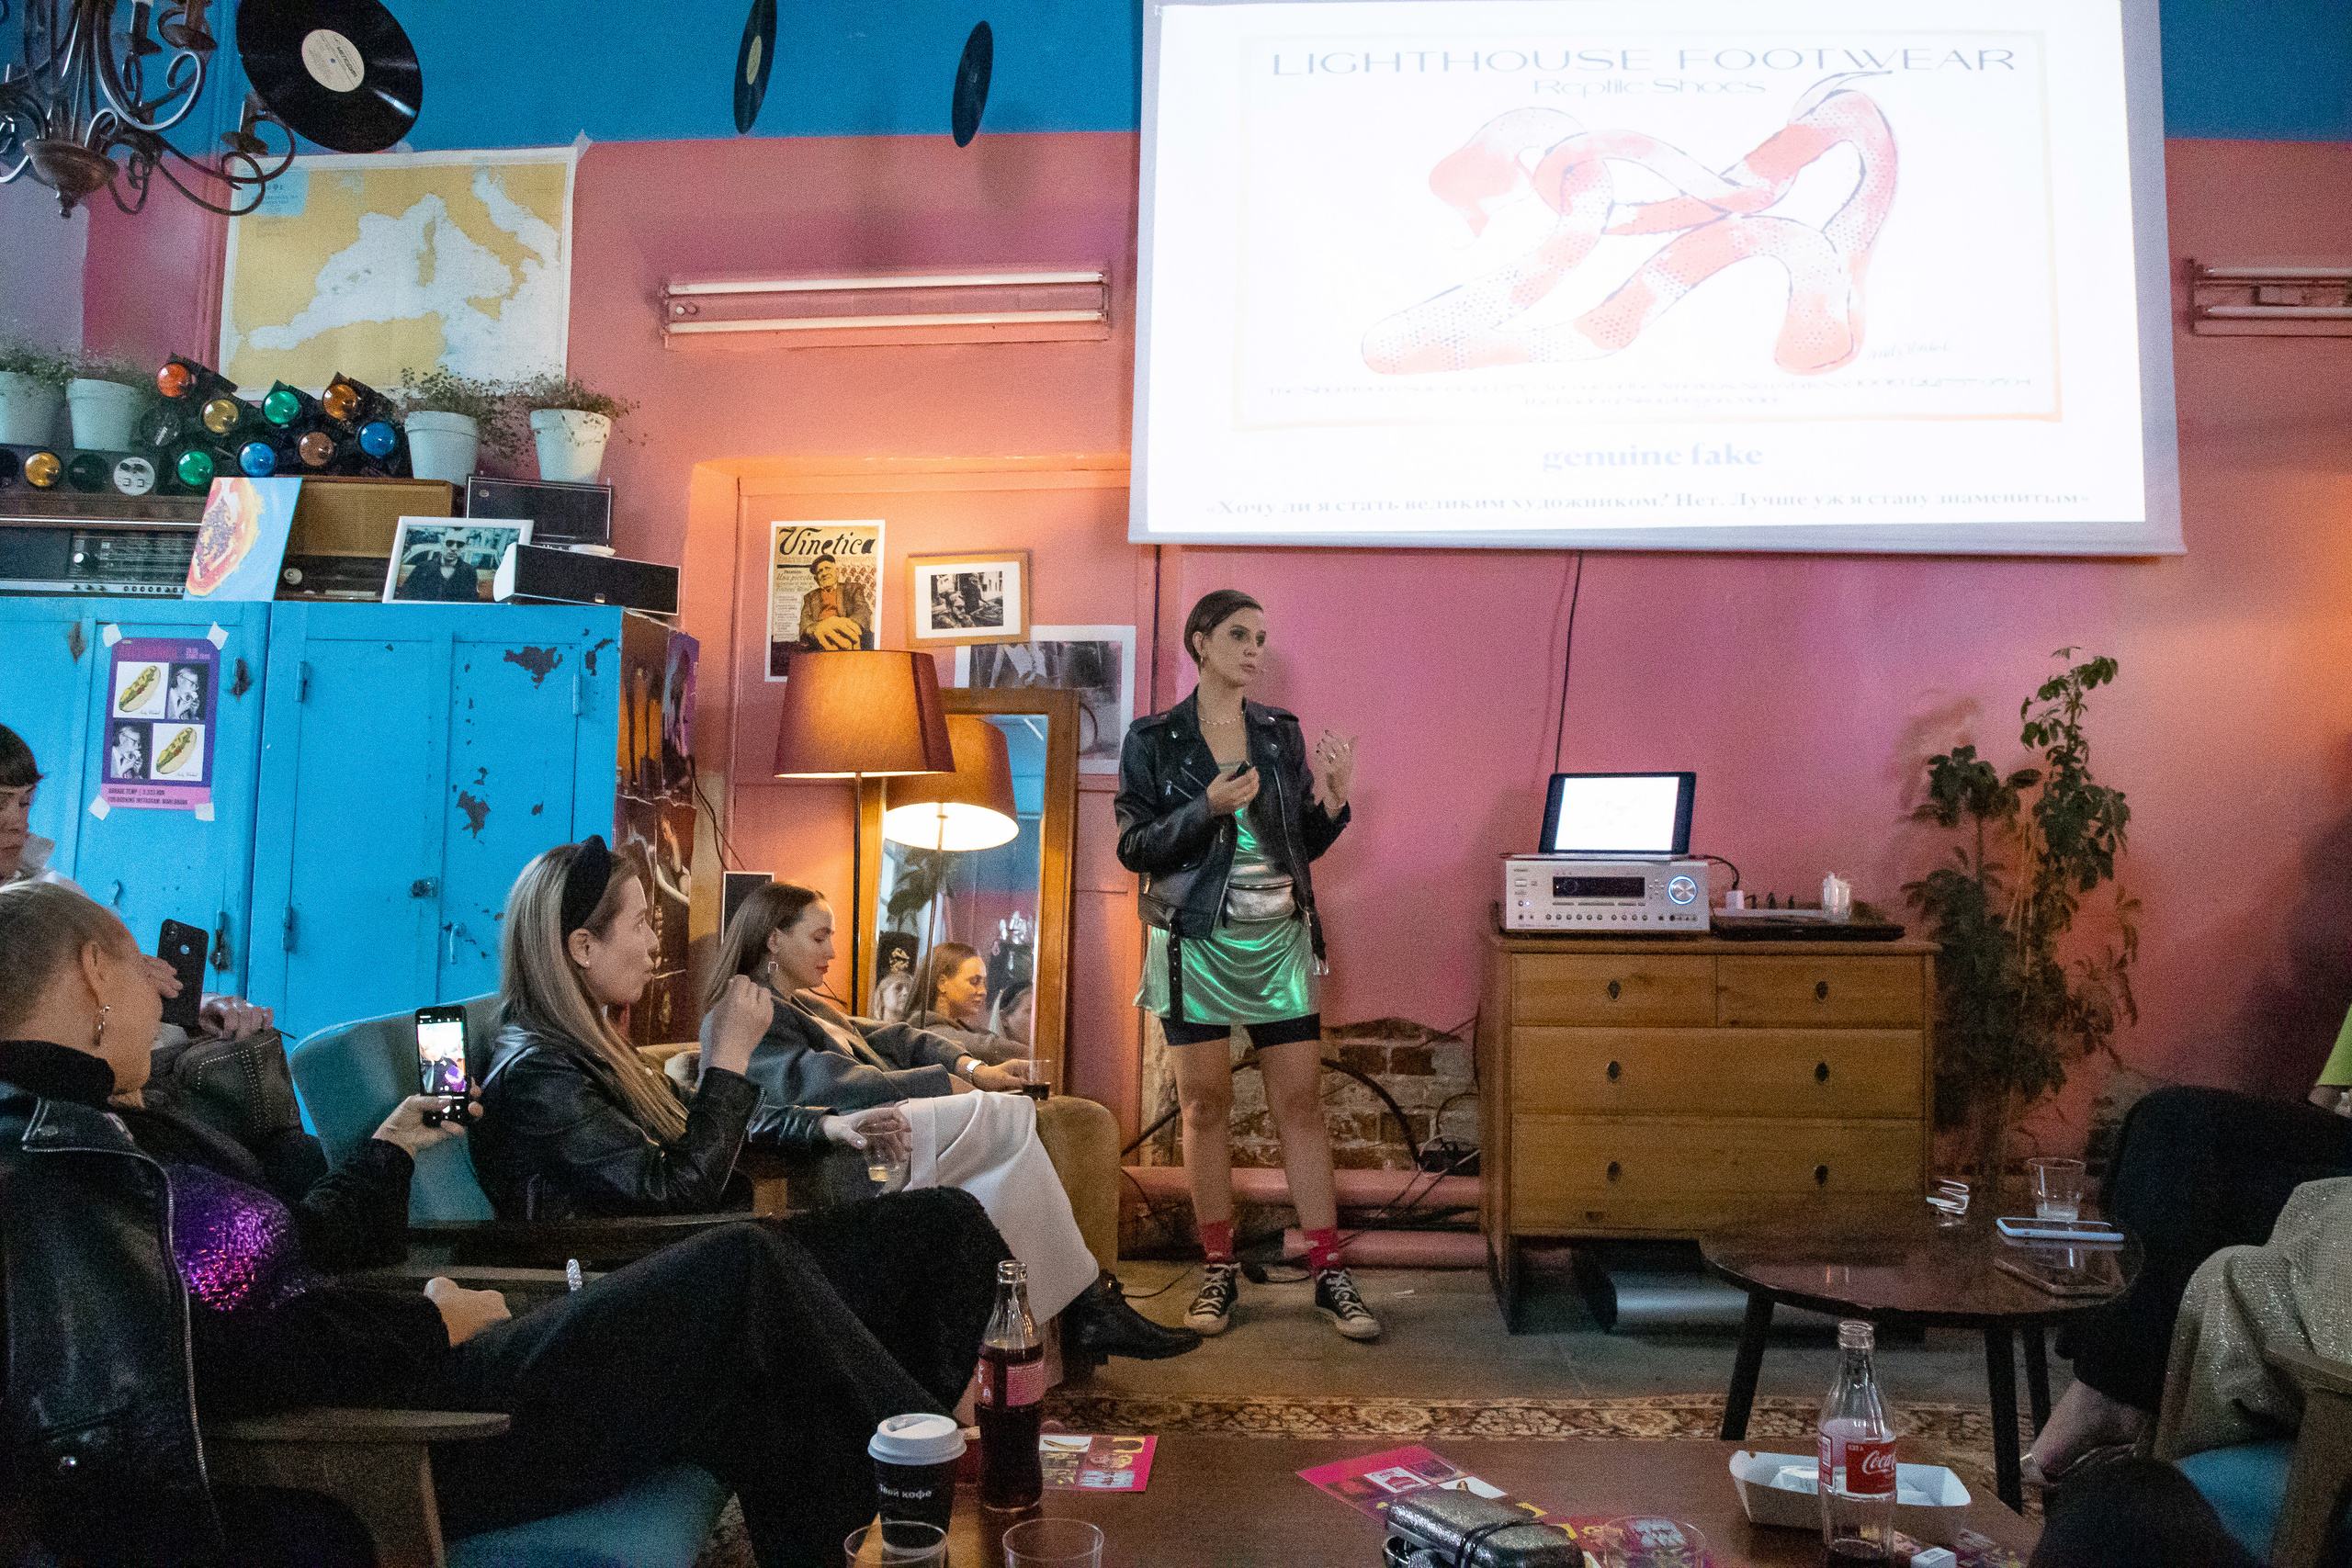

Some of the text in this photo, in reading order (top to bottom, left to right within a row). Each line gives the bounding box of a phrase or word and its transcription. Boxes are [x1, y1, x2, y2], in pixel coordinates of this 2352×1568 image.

[1272, 47, 2017, 75] LIGHTHOUSE FOOTWEAR
[1532, 76, 1767, 98] Reptile Shoes
[1542, 443, 1764, 473] genuine fake
[1283, 502, 1312, 513] ли
[1317, 502, 1330, 513] я
[1334, 501, 1400, 513] стать
[1405, 497, 1506, 512] великим
[1510, 491, 1670, 512] художником?
[1675, 491, 1724, 508] Нет.
[1731, 491, 1808, 511] Лучше
[1812, 495, 1845, 511] уж
[1849, 494, 1863, 505] я
[1868, 494, 1930, 509] стану
[778, 526, 876, 556] Vinetica
[901, 1489, 933, 1500] кофе
